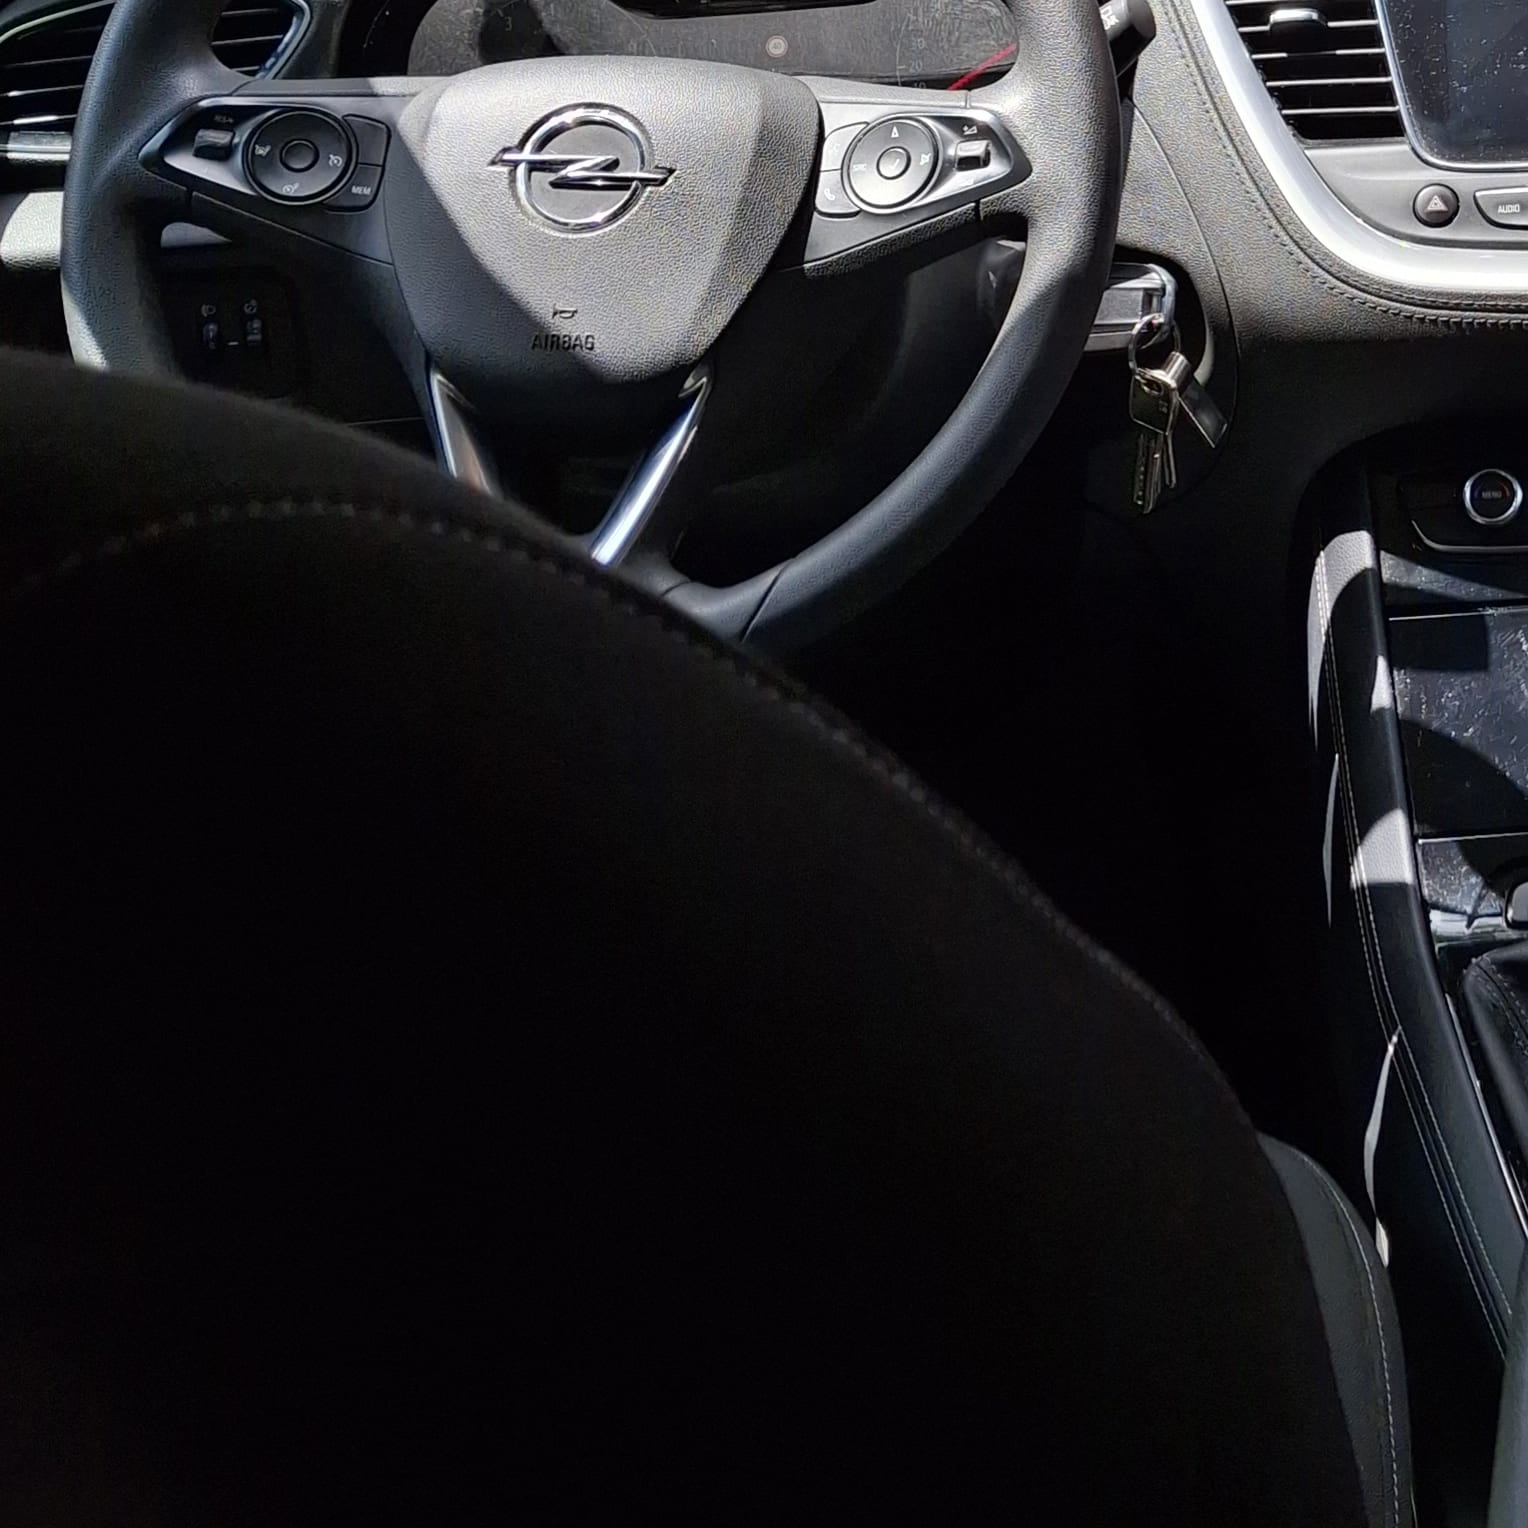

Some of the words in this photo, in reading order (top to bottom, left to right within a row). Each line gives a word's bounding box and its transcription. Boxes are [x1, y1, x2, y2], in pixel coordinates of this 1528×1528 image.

[351, 185, 372, 196] MEM
[1497, 203, 1520, 213] AUDIO
[531, 333, 596, 352] AIRBAG
